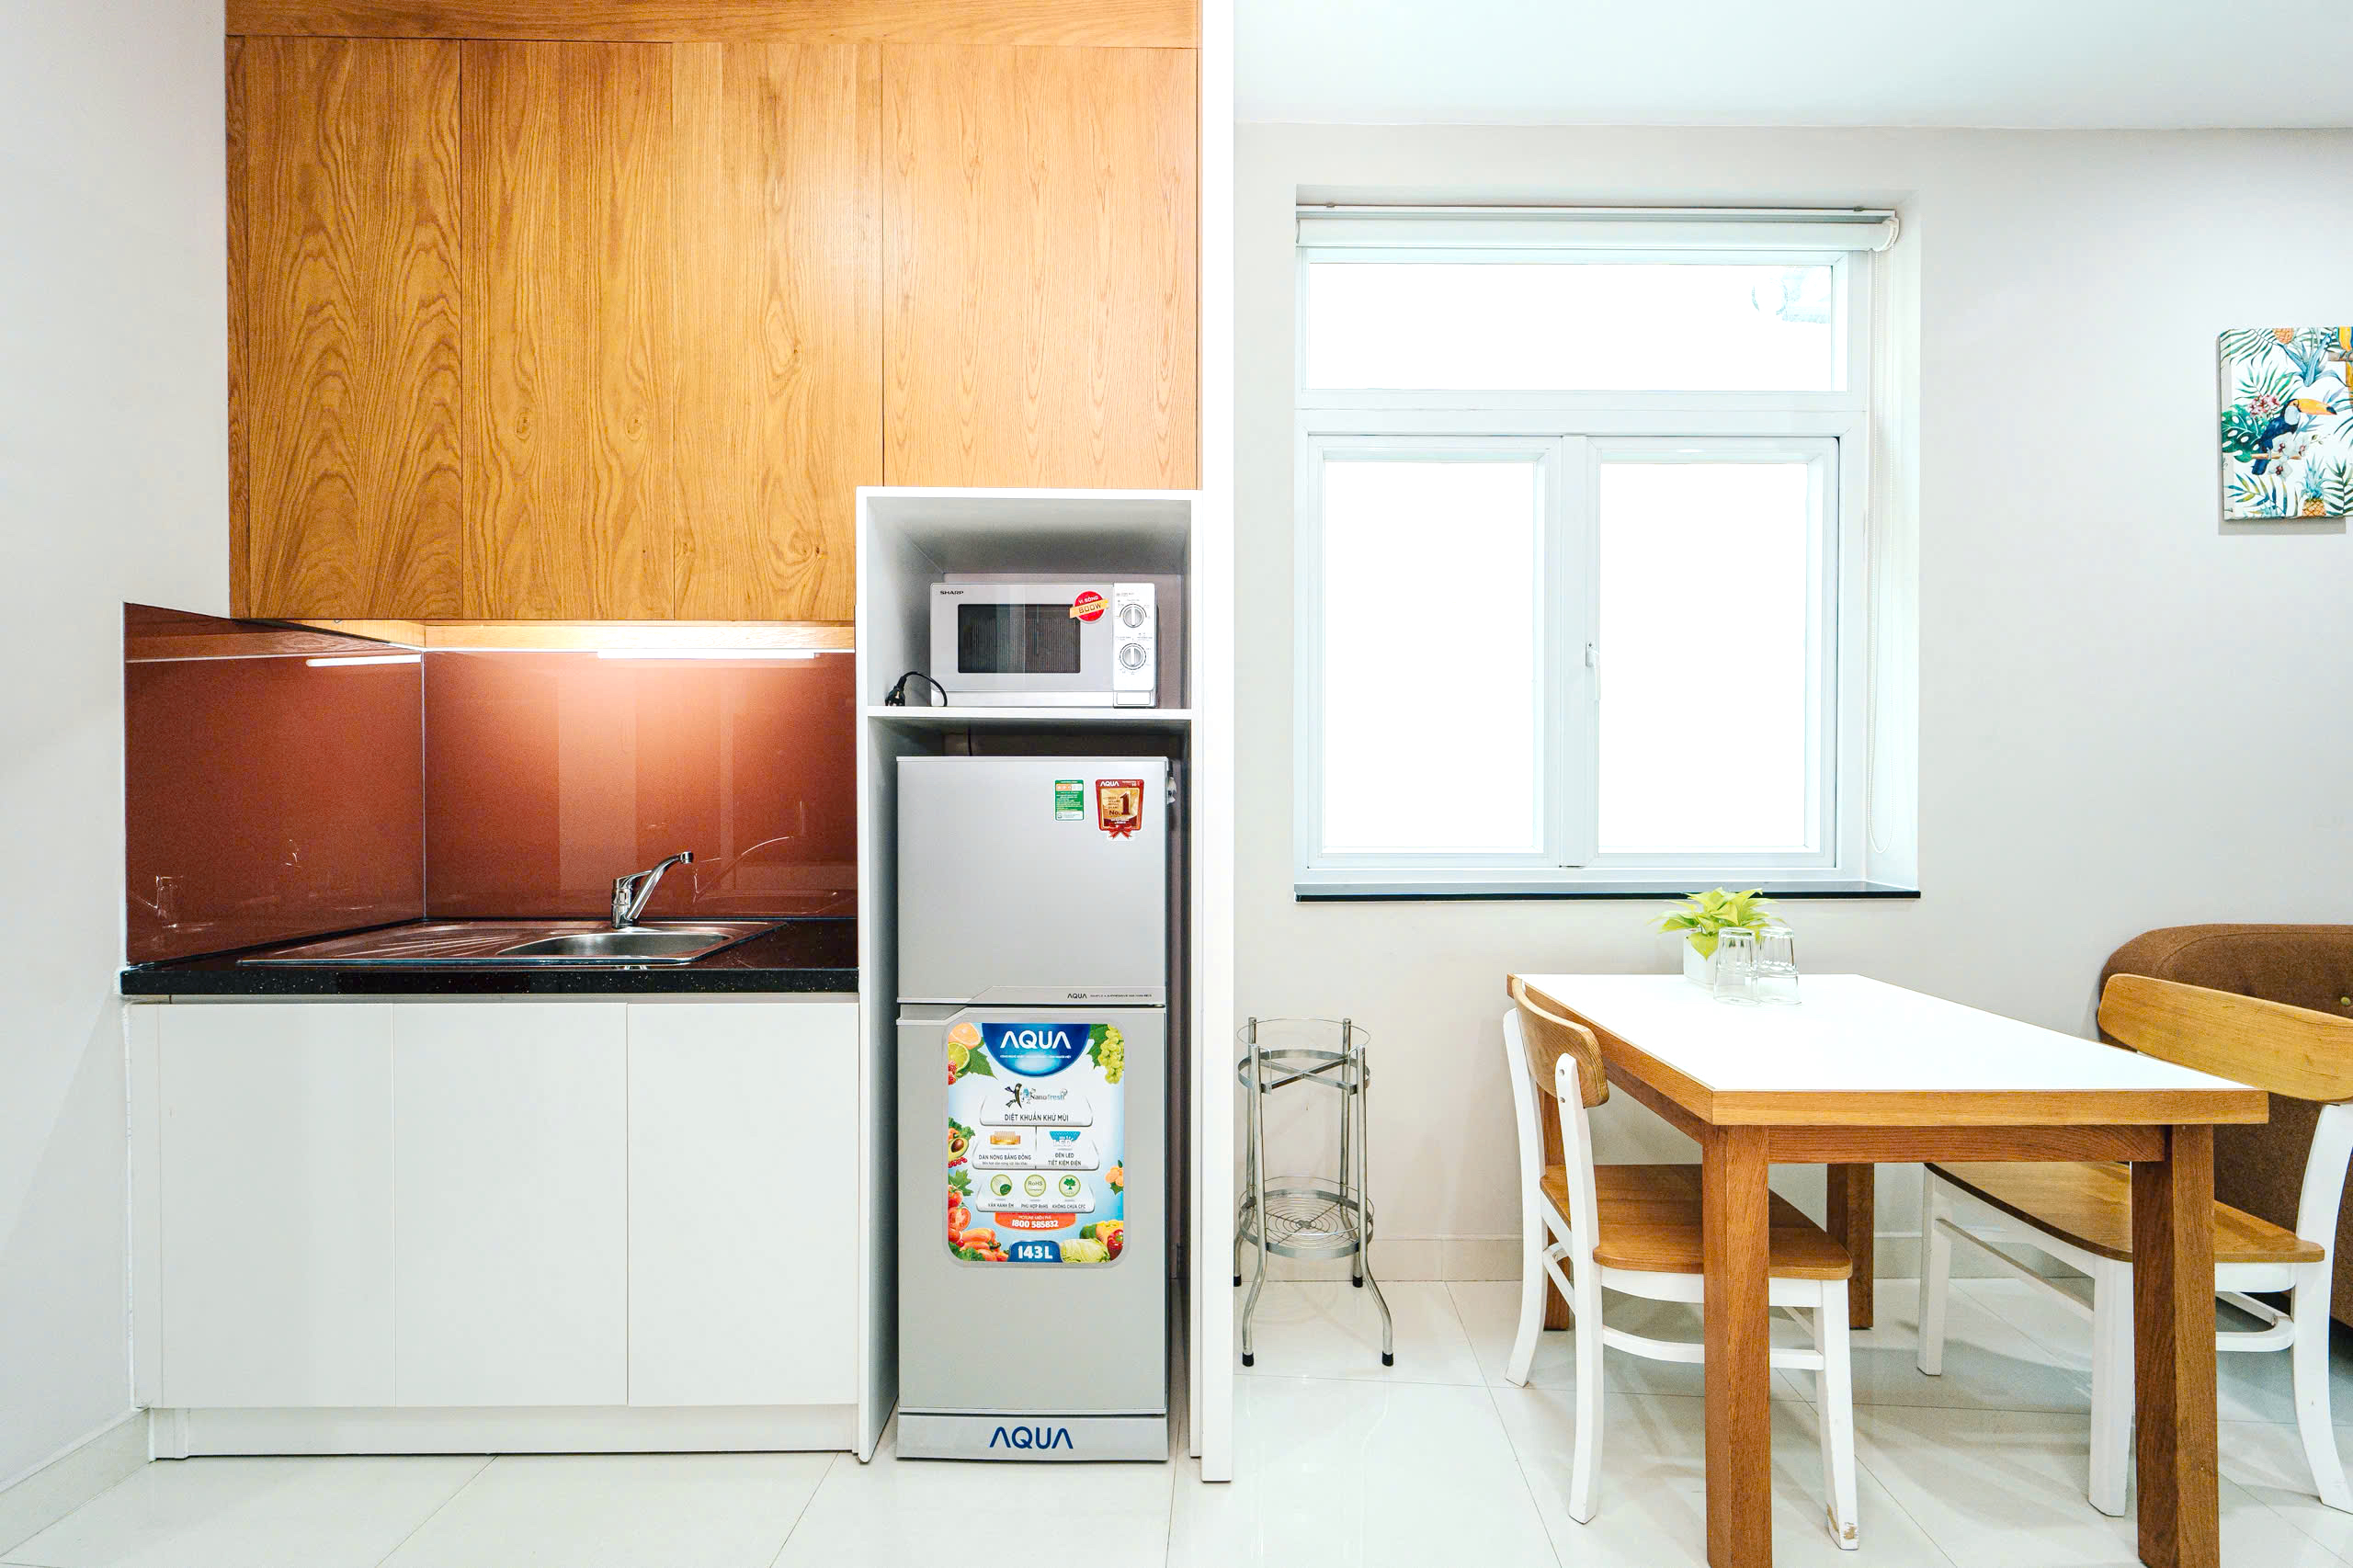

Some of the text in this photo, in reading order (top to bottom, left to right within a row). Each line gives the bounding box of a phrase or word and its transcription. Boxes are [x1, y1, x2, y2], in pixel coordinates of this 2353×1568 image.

[1000, 1029, 1072, 1050] AQUA
[1012, 1219, 1059, 1228] 1800 585832
[1018, 1245, 1053, 1259] 143L
[989, 1426, 1074, 1449] AQUA
